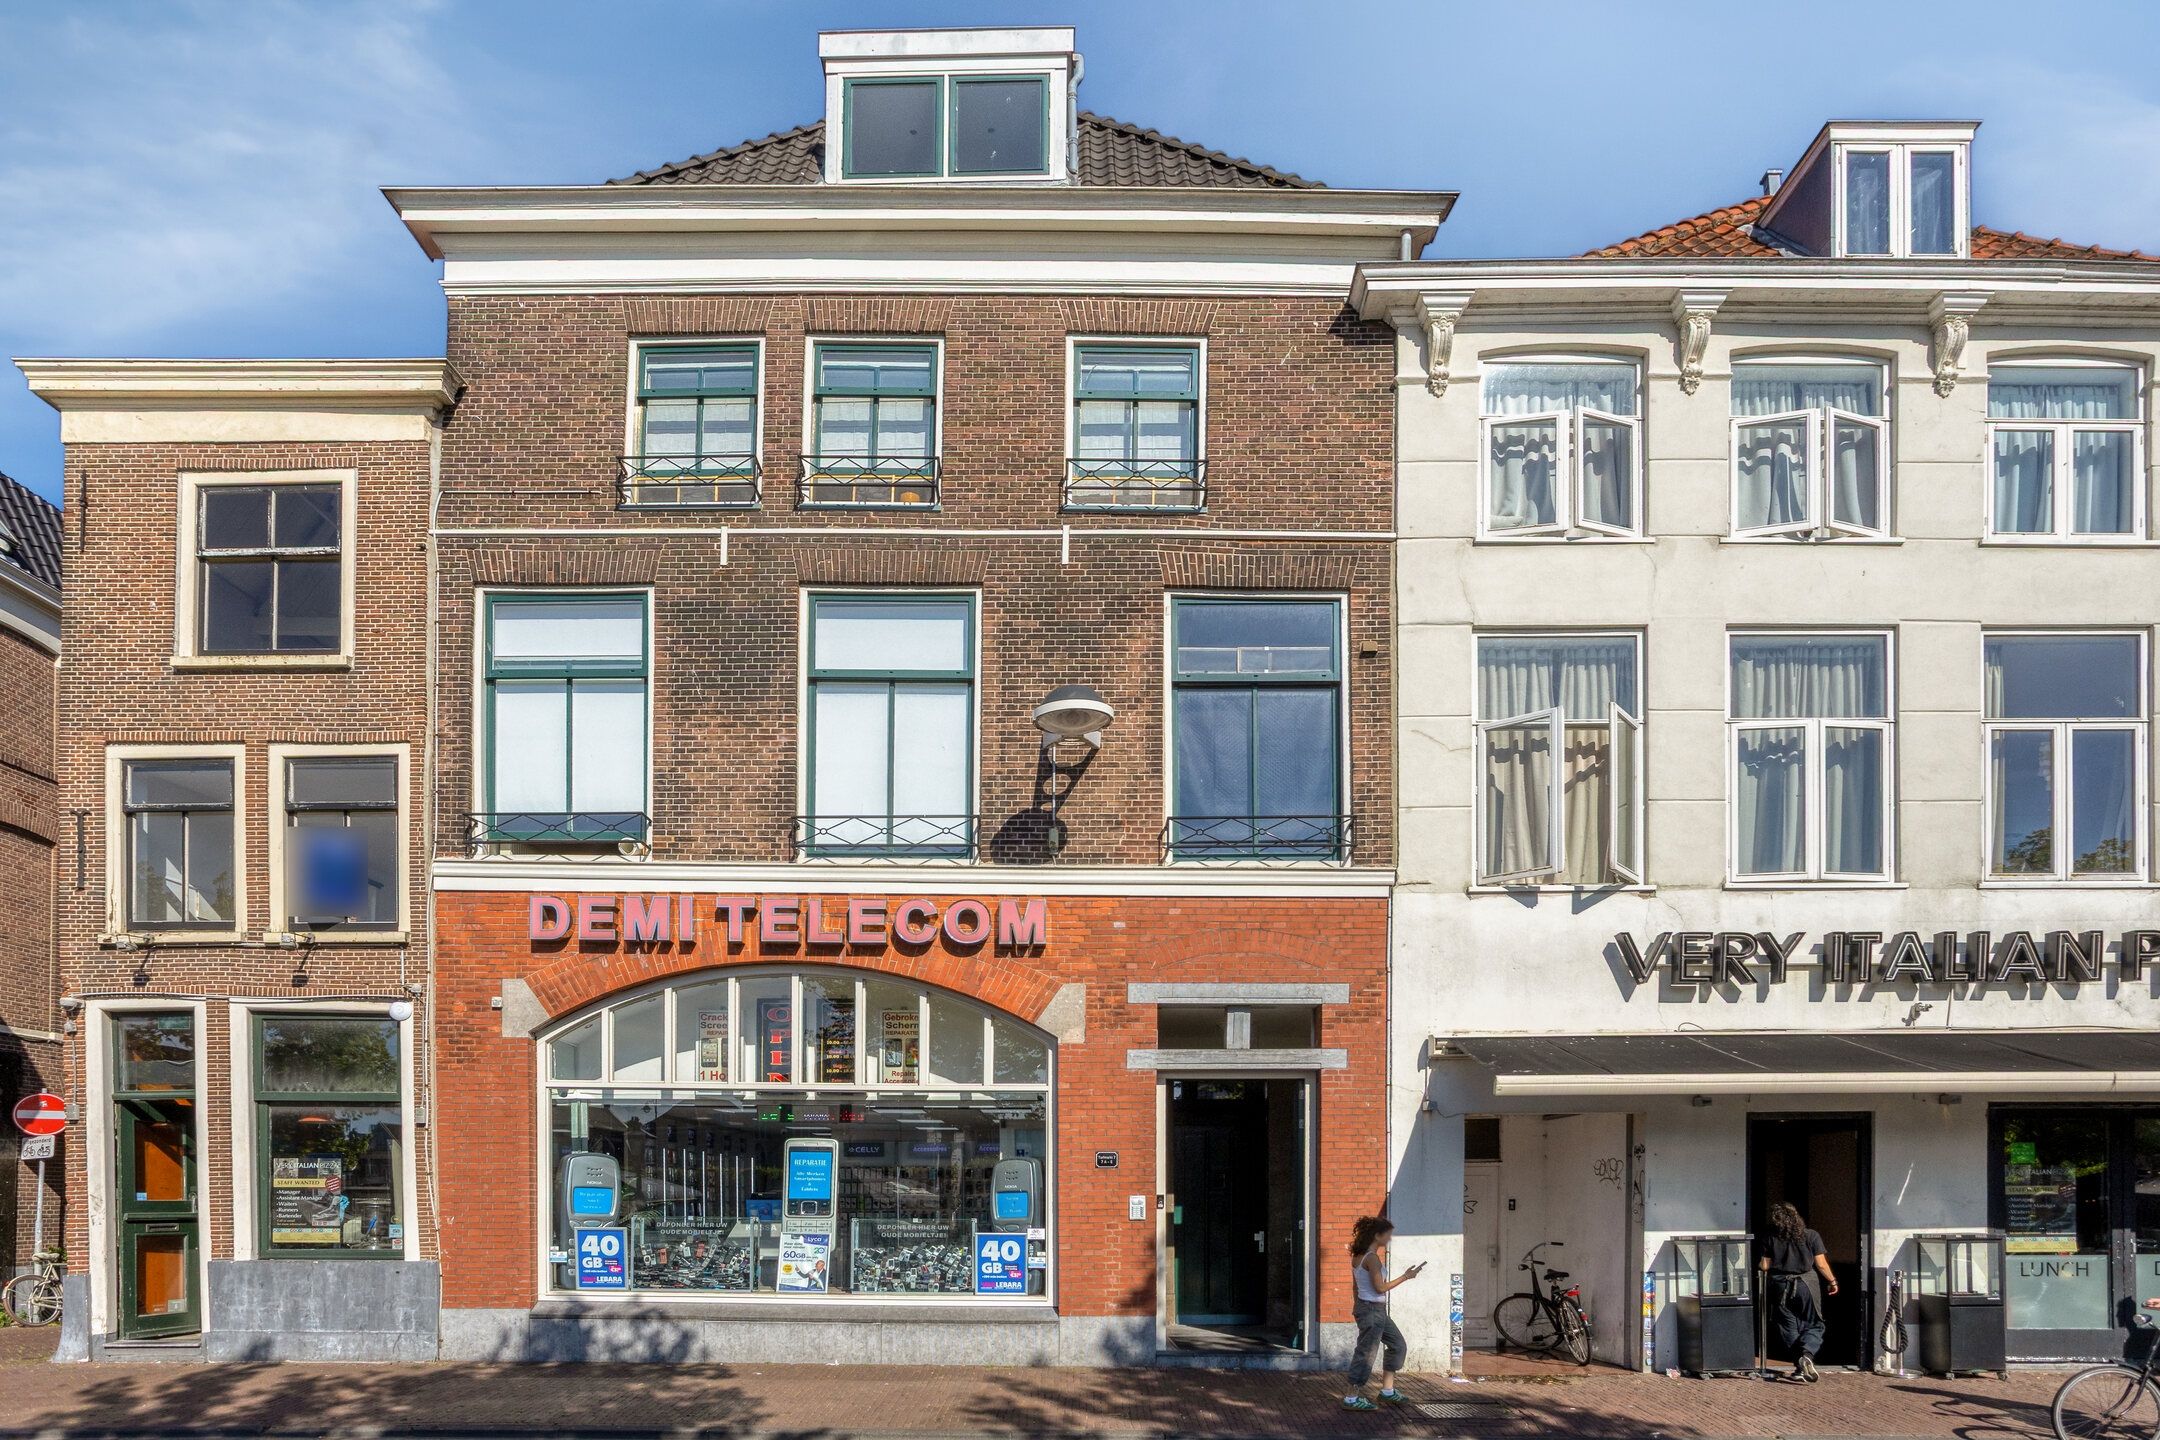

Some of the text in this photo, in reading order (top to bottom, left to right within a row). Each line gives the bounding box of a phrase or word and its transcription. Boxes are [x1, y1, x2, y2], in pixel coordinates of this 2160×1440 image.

[530, 896, 1047, 945] DEMI TELECOM
[1614, 932, 1806, 985] VERY
[1823, 931, 2103, 983] ITALIAN
[581, 1235, 620, 1257] 40
[783, 1250, 806, 1259] 60GB
[981, 1240, 1021, 1262] 40
[582, 1257, 603, 1268] GB
[981, 1262, 1003, 1274] GB
[2020, 1262, 2089, 1276] LUNCH
